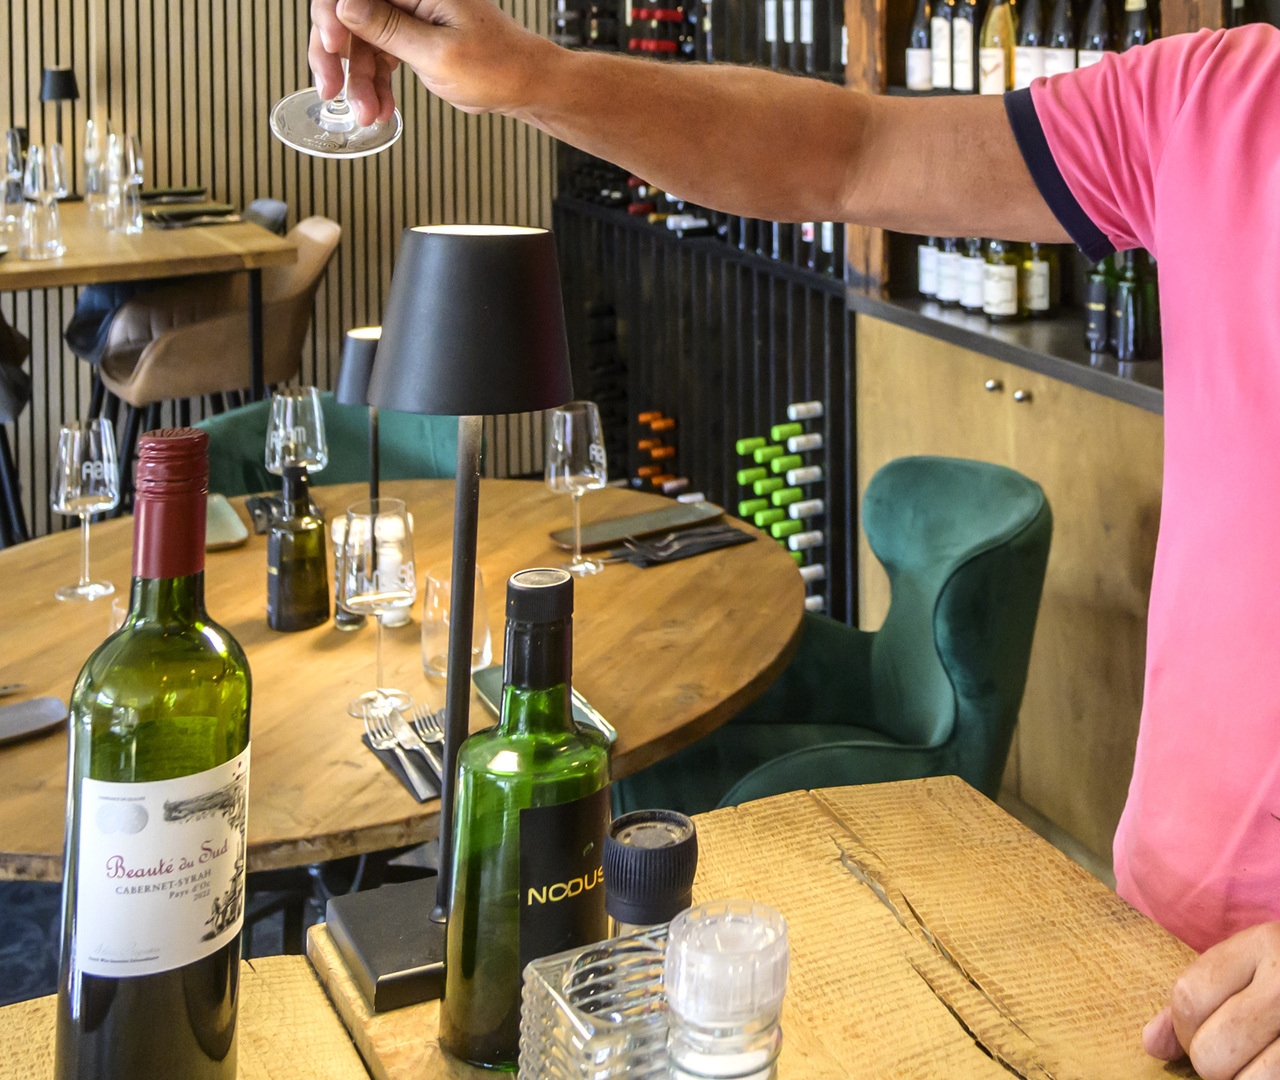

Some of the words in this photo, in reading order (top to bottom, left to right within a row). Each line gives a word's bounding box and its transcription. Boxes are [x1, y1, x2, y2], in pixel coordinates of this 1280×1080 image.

[106, 854, 174, 879] Beauté
[178, 857, 195, 871] du
[198, 838, 228, 864] Sud
[115, 869, 212, 895] CABERNET-SYRAH
